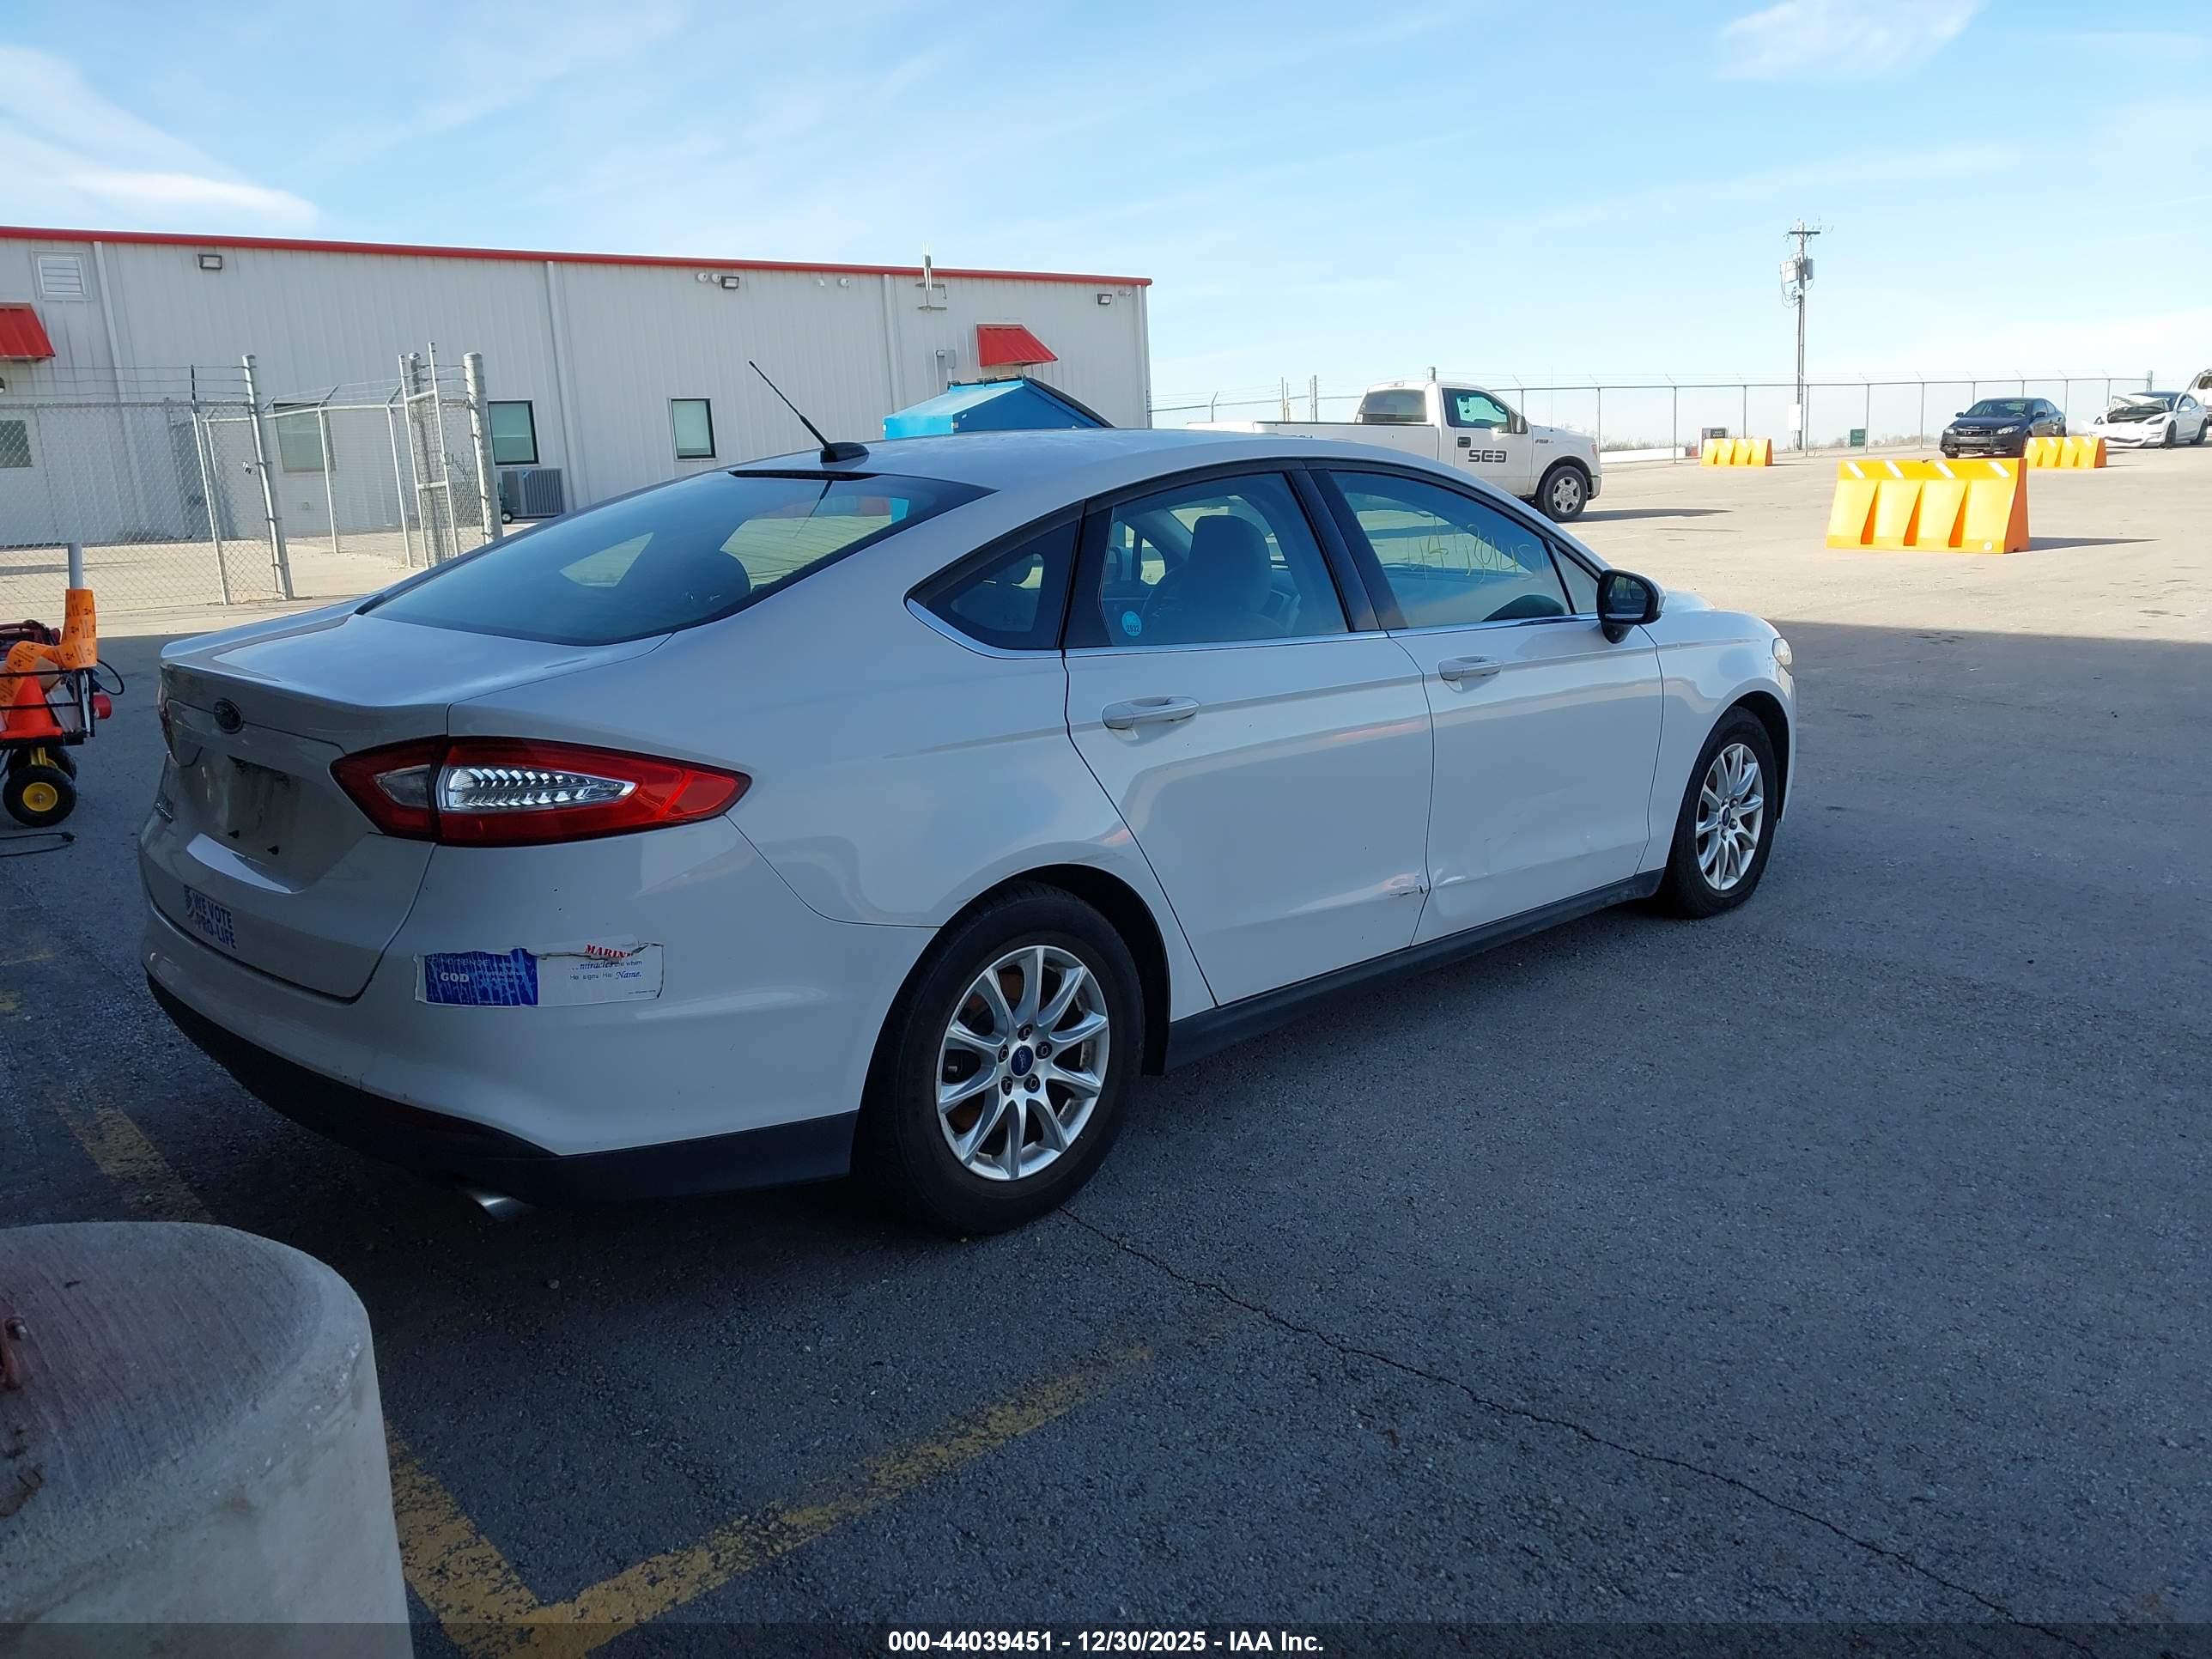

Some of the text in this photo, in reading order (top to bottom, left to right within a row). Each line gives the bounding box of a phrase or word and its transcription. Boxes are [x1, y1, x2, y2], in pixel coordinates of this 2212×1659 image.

[192, 893, 233, 929] WE VOTE
[196, 912, 236, 948] PRO-LIFE
[440, 972, 470, 982] GOD
[616, 970, 642, 981] Name.
